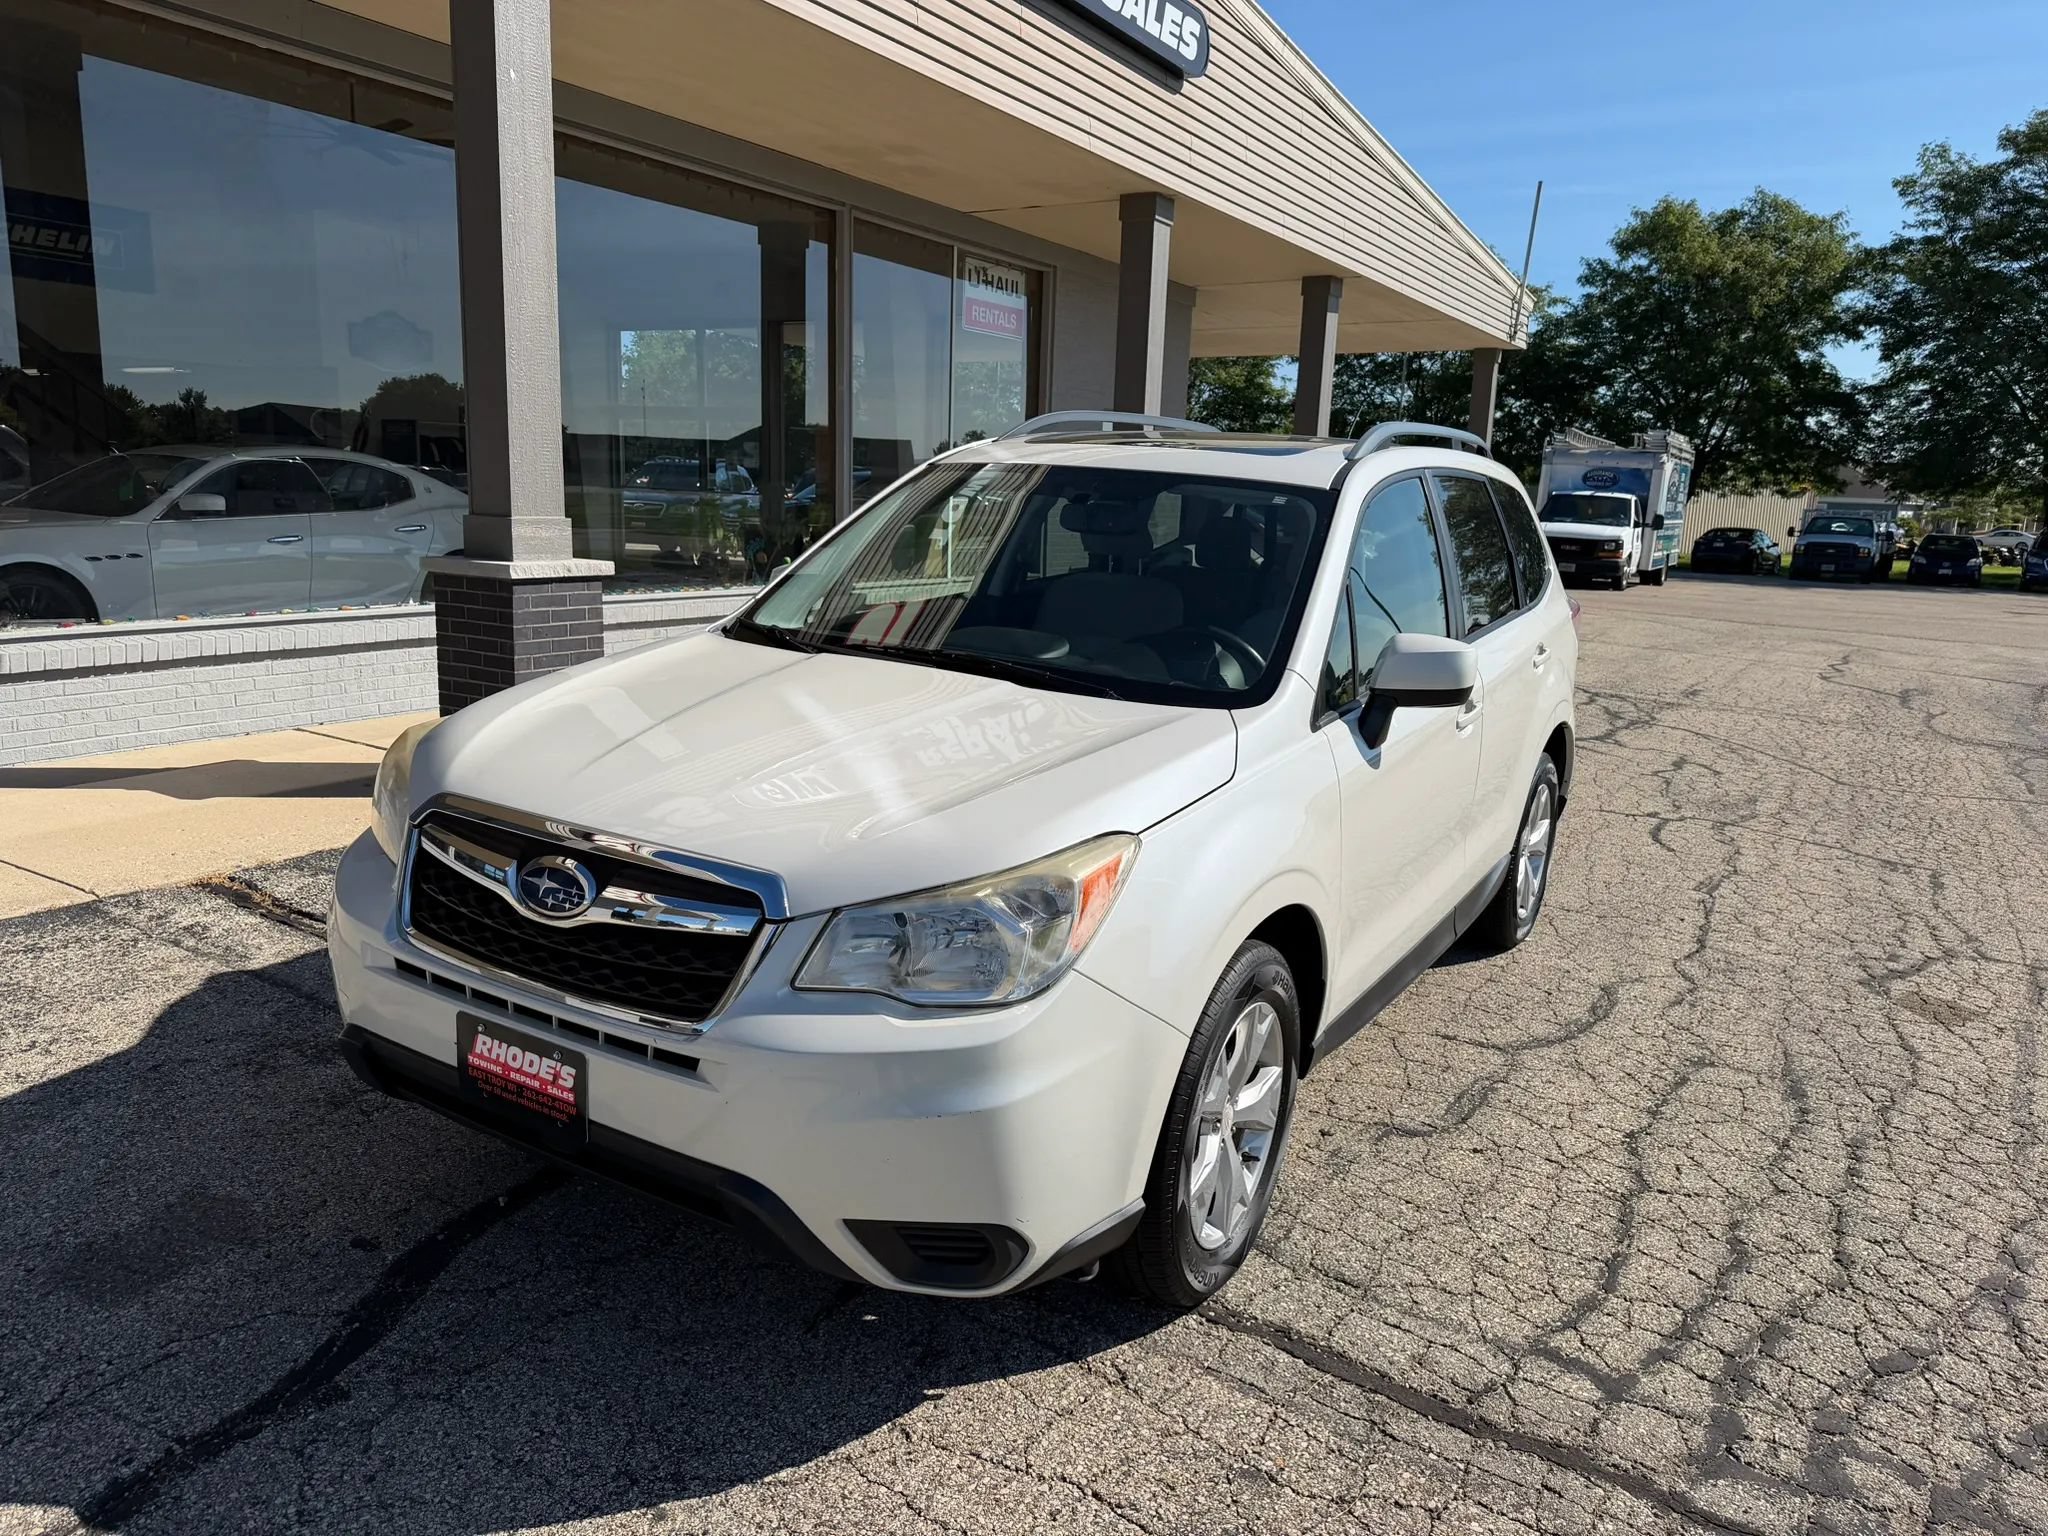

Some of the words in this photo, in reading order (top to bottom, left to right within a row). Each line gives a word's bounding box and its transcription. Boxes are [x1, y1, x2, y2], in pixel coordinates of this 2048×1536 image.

[1101, 0, 1200, 61] ALES
[972, 304, 1017, 329] RENTALS
[467, 1055, 504, 1075] TOWING
[509, 1070, 541, 1090] REPAIR
[546, 1085, 575, 1101] SALES
[468, 1066, 487, 1084] EAST
[487, 1073, 507, 1091] TROY
[473, 1033, 577, 1089] RHODE'S
[501, 1089, 517, 1103] used
[516, 1094, 542, 1112] vehicles
